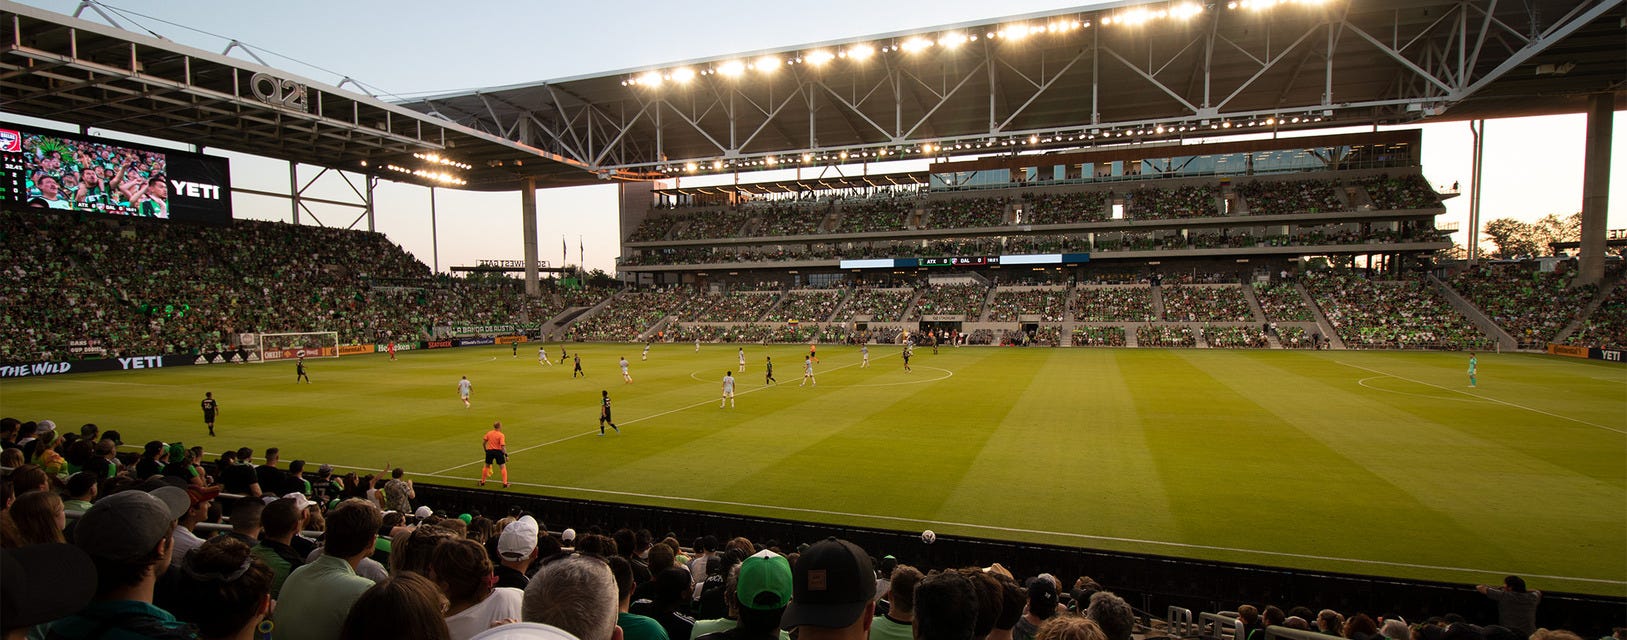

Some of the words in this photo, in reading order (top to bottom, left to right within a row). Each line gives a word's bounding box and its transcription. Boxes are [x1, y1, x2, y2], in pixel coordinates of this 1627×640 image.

[250, 72, 301, 111] Q2
[170, 179, 220, 200] YETI
[463, 326, 484, 334] BANDA
[428, 341, 452, 349] SEATGEEK
[118, 355, 162, 369] YETI
[1601, 350, 1620, 361] YETI
[0, 364, 31, 377] THE
[32, 361, 71, 376] WILD
